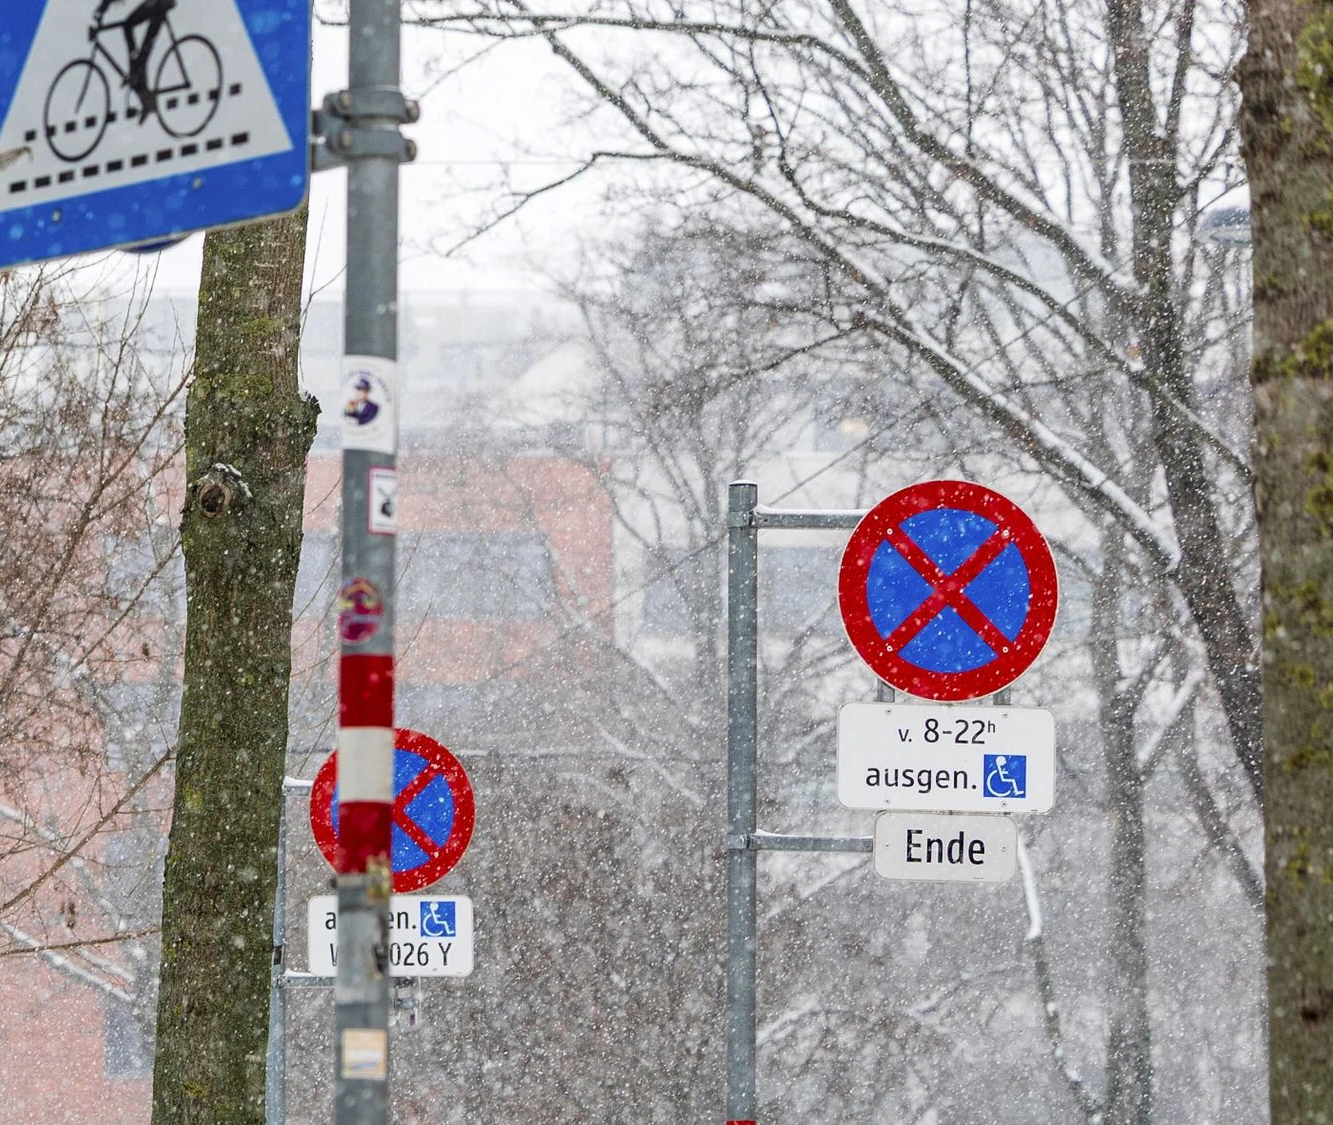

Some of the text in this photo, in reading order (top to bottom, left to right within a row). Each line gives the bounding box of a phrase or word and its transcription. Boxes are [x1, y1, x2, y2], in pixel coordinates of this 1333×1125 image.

[898, 728, 912, 743] v.
[865, 767, 978, 794] ausgen.
[906, 829, 986, 866] Ende
[438, 942, 452, 966] Y
